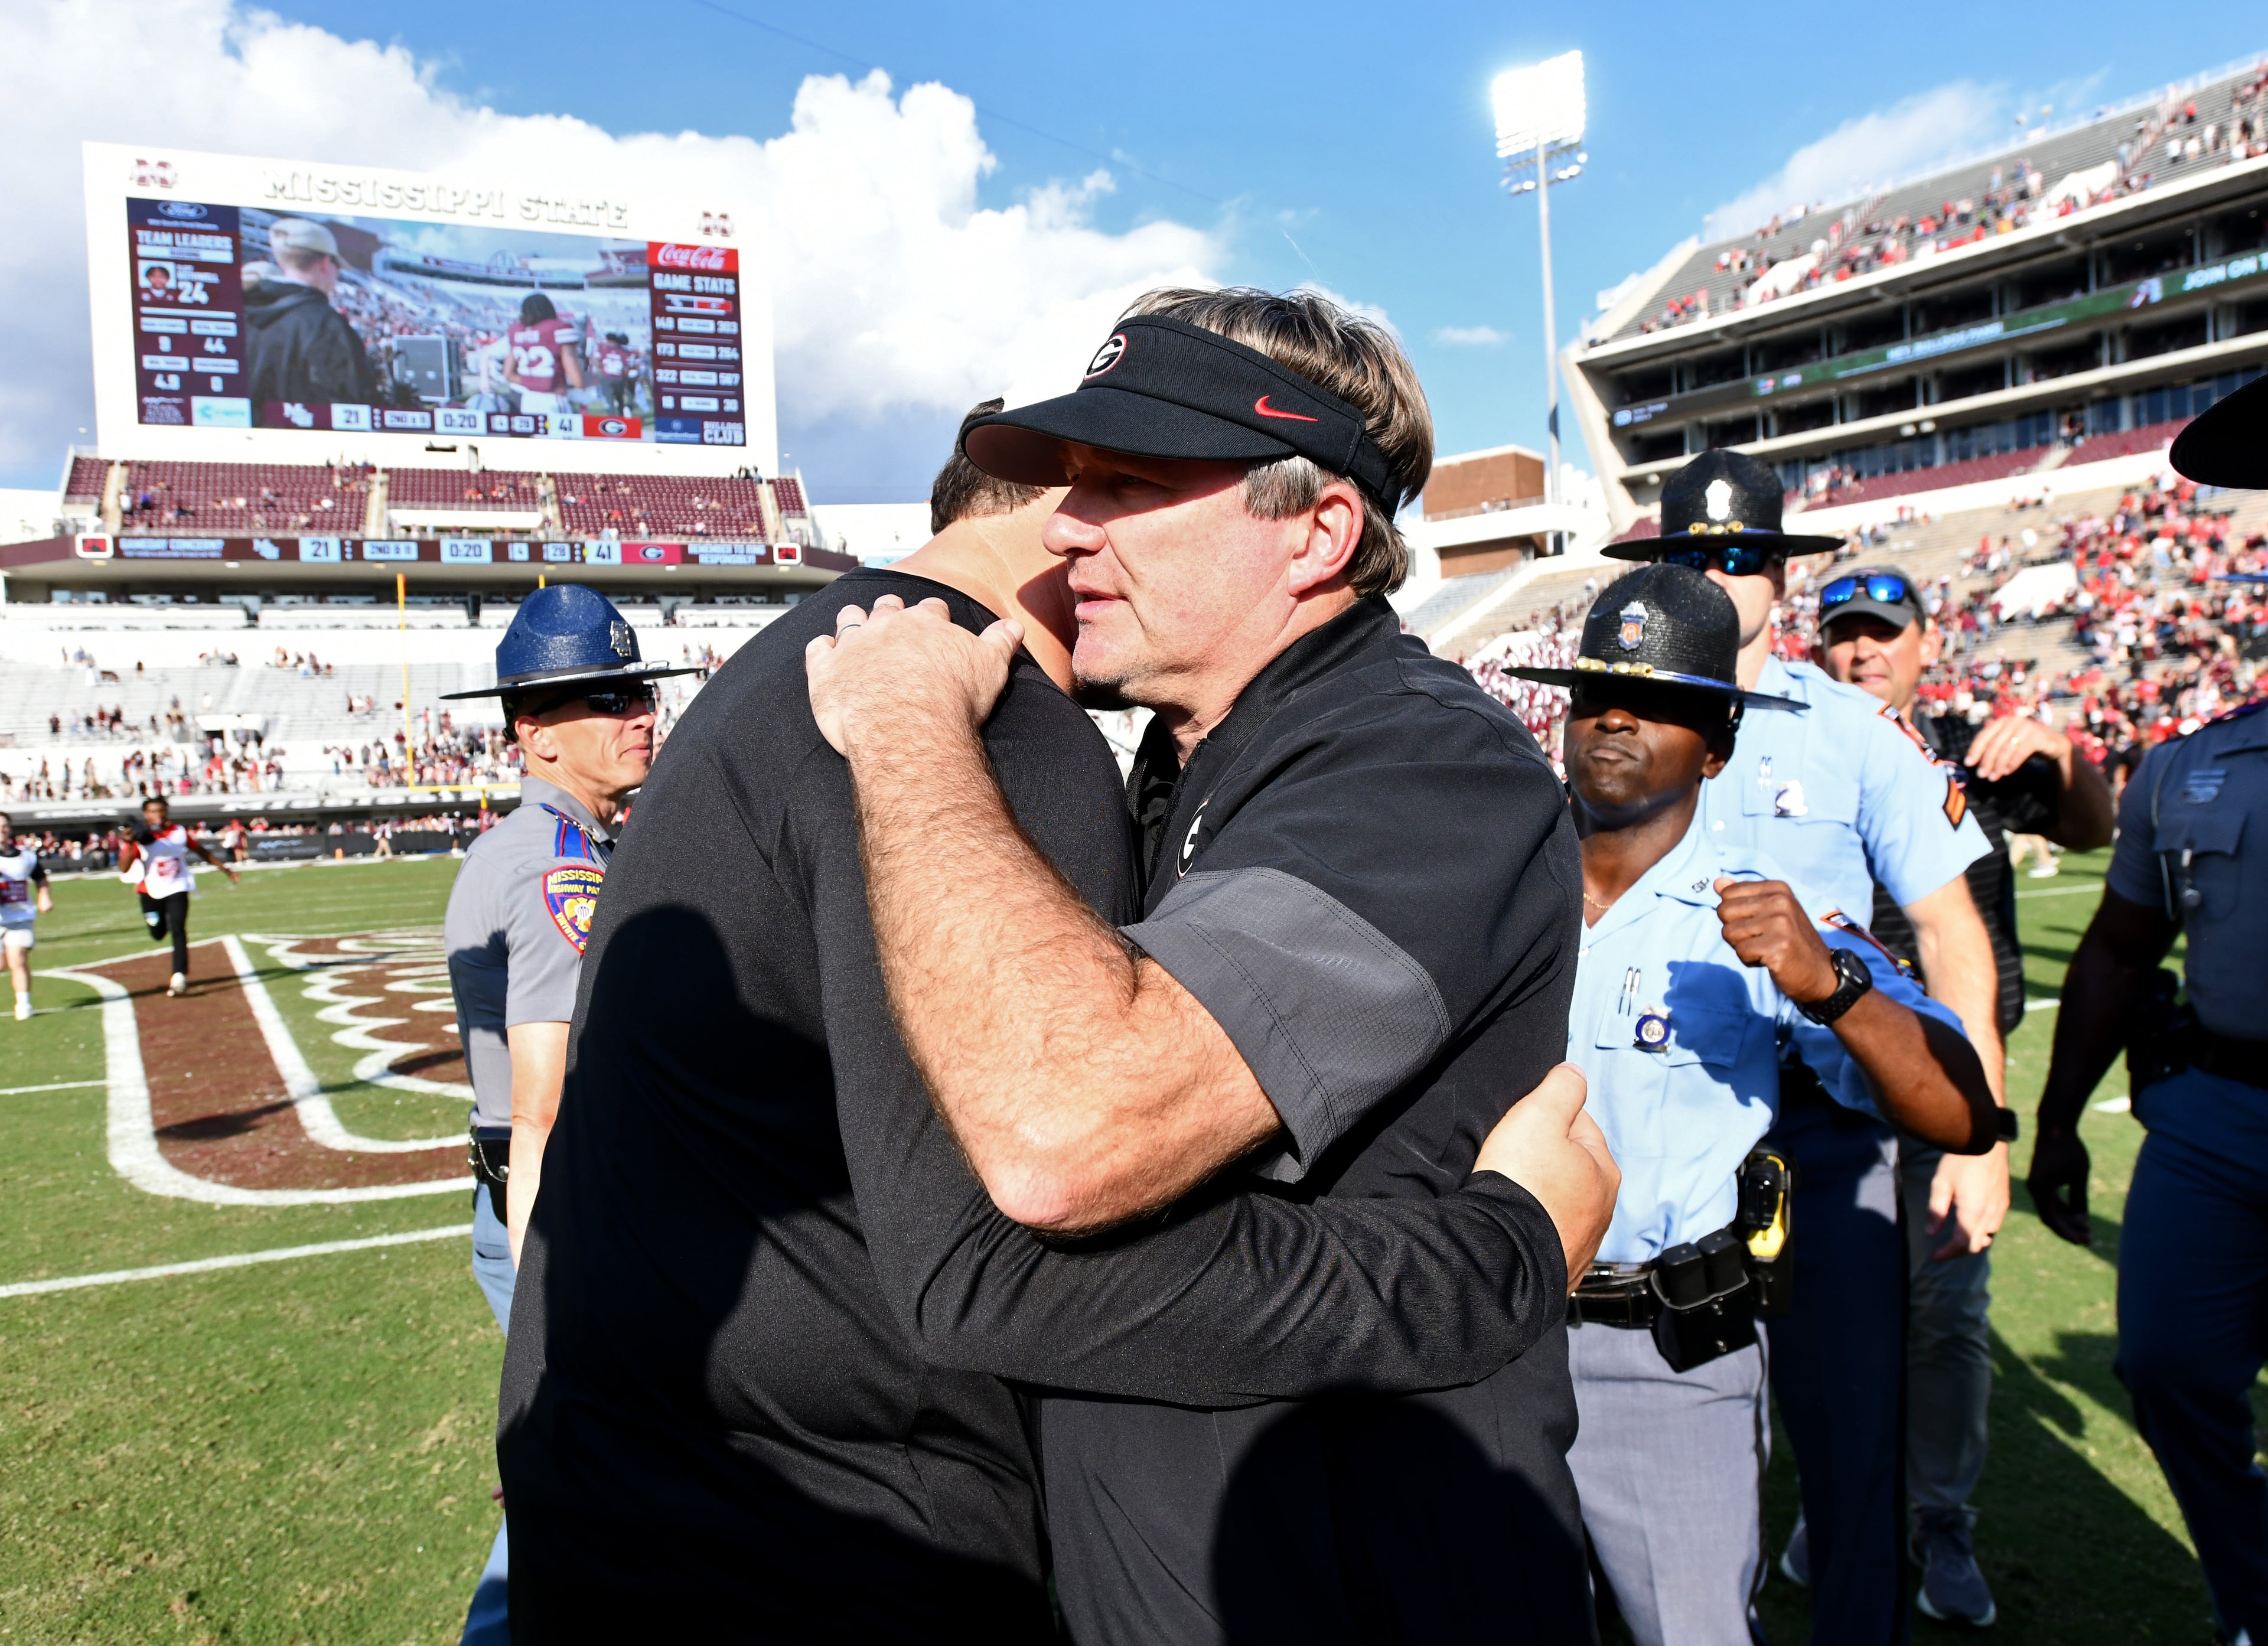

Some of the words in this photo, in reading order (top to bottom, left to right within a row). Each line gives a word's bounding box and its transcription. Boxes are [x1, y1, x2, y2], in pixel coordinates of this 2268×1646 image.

[264, 170, 505, 218] MISSISSIPPI
[519, 192, 628, 230] STATE
[136, 230, 174, 246] TEAM
[175, 233, 233, 252] LEADERS
[2182, 264, 2227, 291] JOIN
[2227, 256, 2258, 278] ON
[653, 273, 692, 292] GAME
[693, 276, 736, 295] STATS
[178, 282, 209, 304] 24
[1088, 337, 1124, 374] G
[656, 369, 678, 383] 322
[344, 409, 360, 424] 21
[444, 413, 477, 428] 0:20
[559, 419, 572, 432] 41
[703, 429, 744, 445] CLUB
[311, 540, 329, 558] 21
[449, 543, 483, 558] 0:20
[597, 544, 611, 560] 41
[547, 869, 604, 884] MISSISSIP
[548, 884, 585, 894] HIGHWAY
